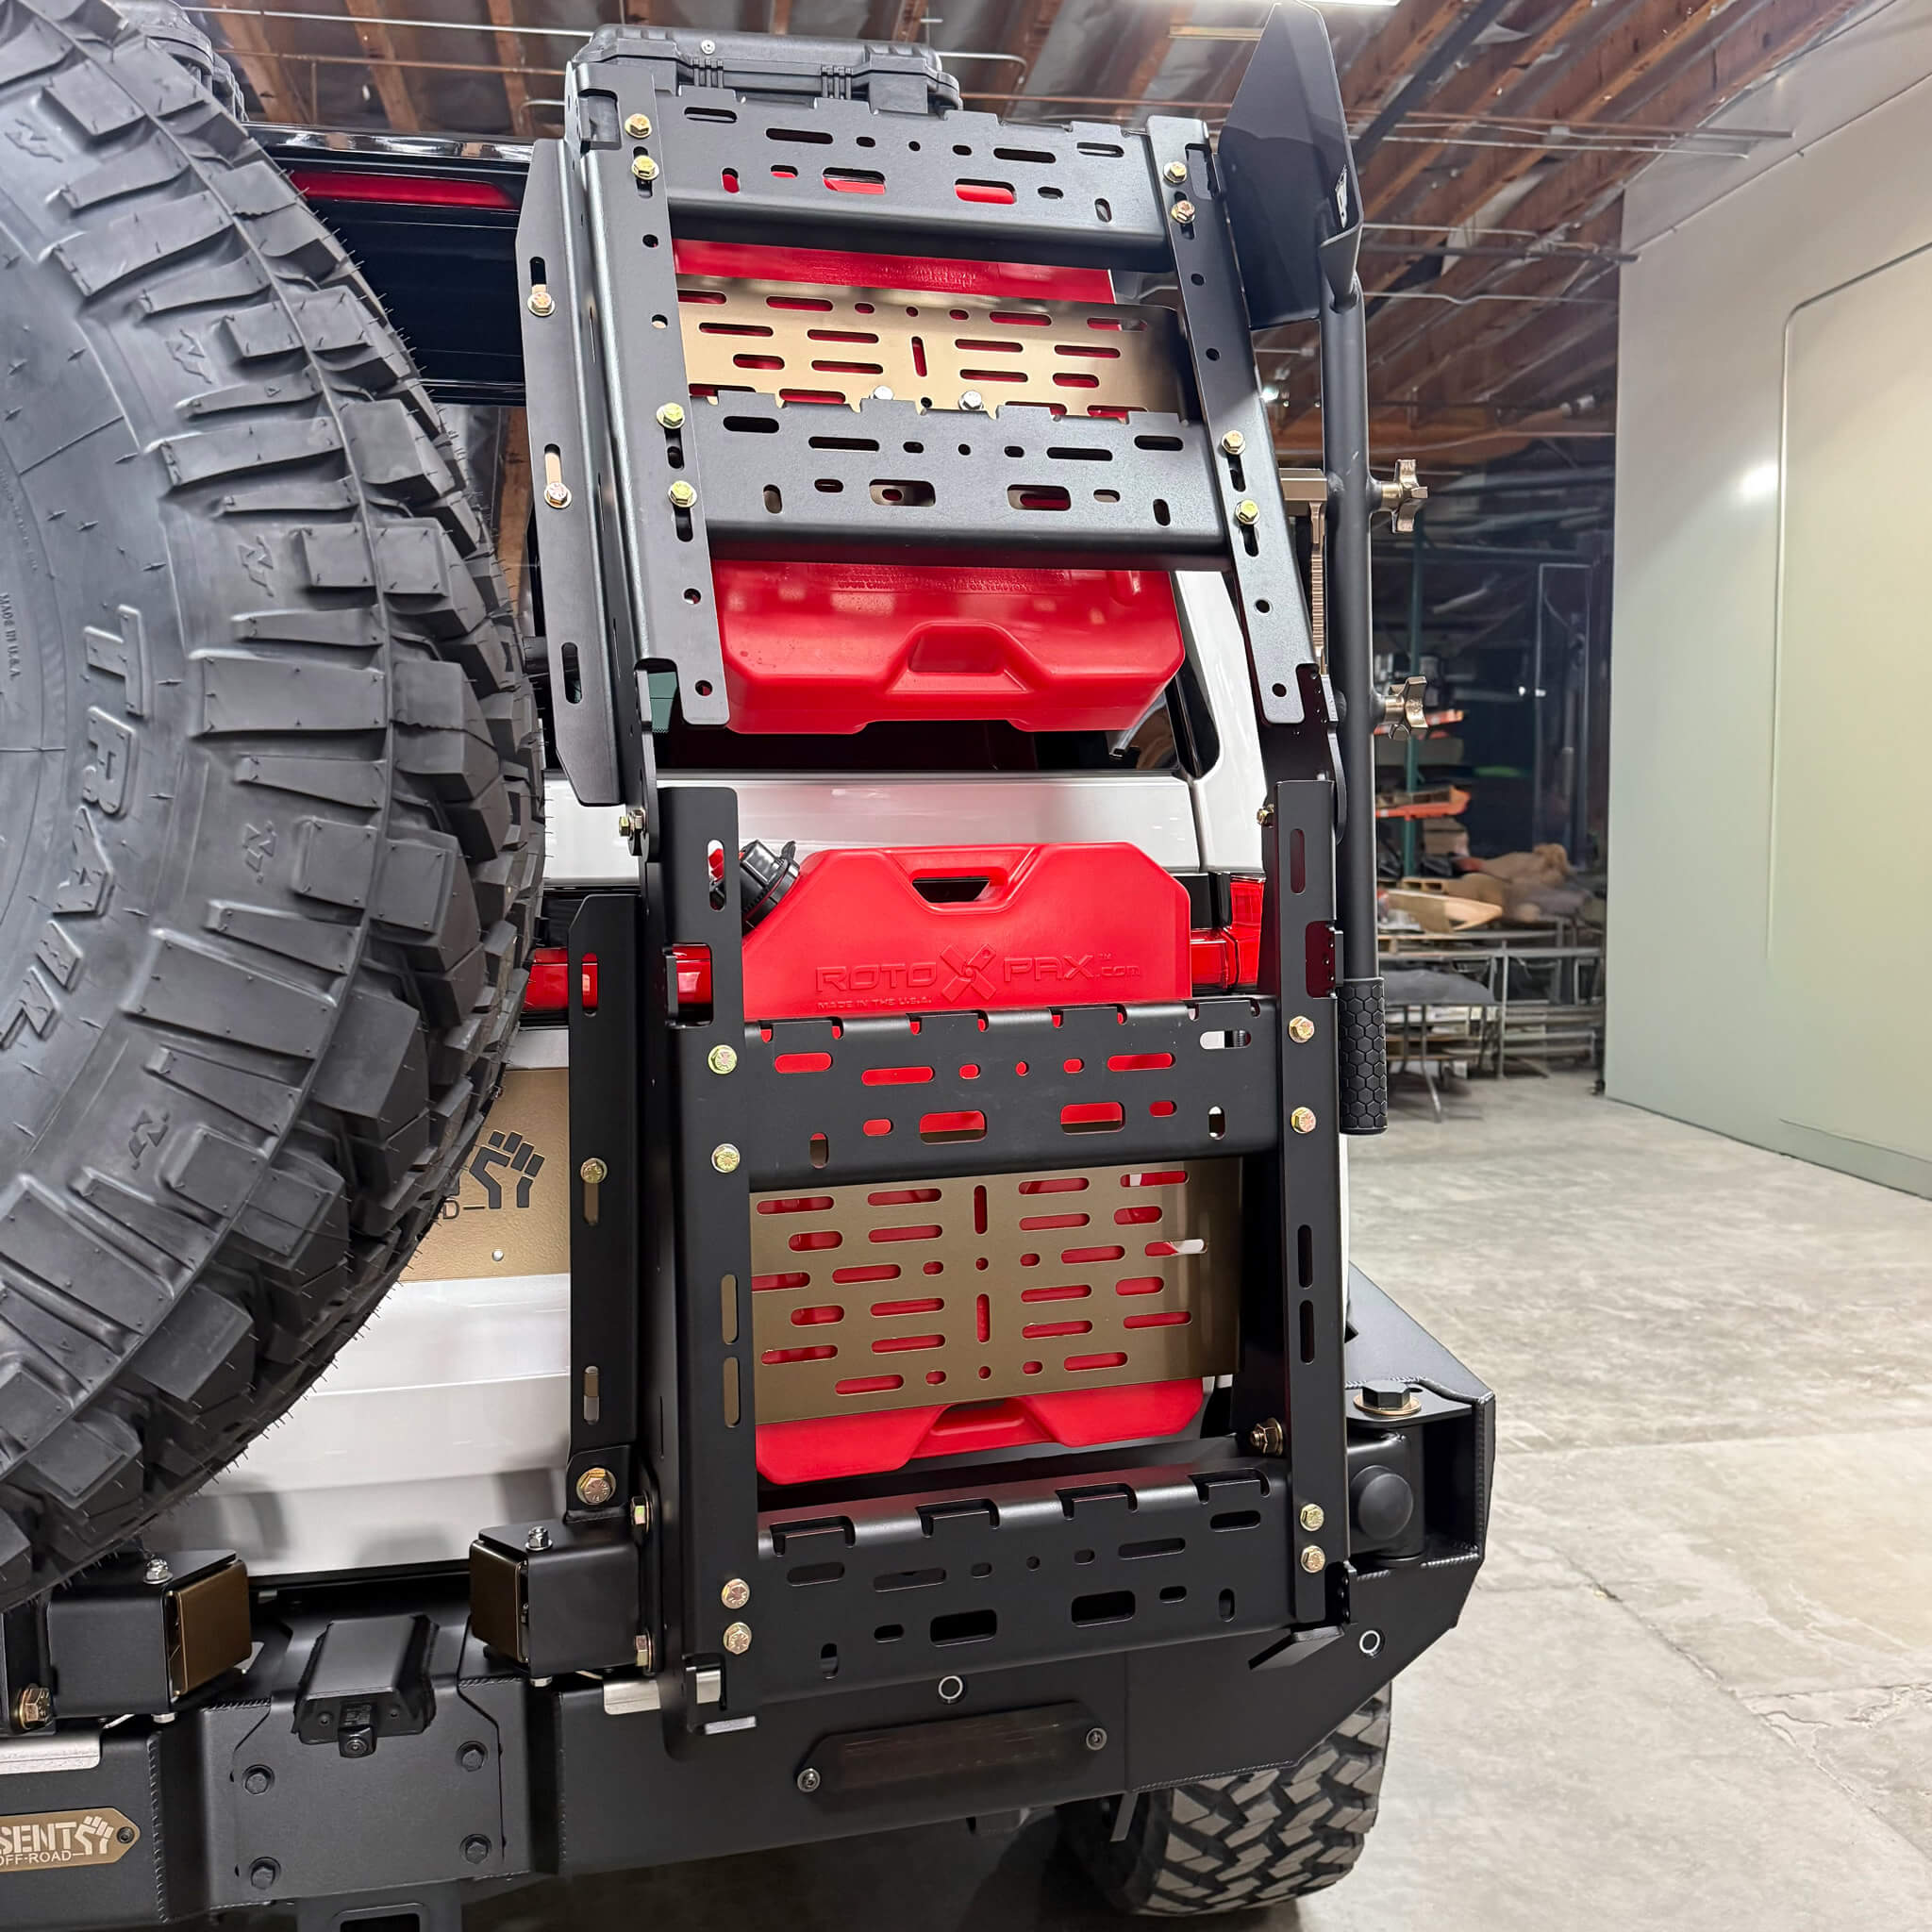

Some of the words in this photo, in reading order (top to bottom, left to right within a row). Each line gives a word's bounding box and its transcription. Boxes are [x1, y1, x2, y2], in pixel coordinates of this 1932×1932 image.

[0, 604, 148, 1050] TRAIL
[816, 961, 937, 993] ROTO
[817, 1000, 853, 1009] MADE
[871, 998, 895, 1007] THE
